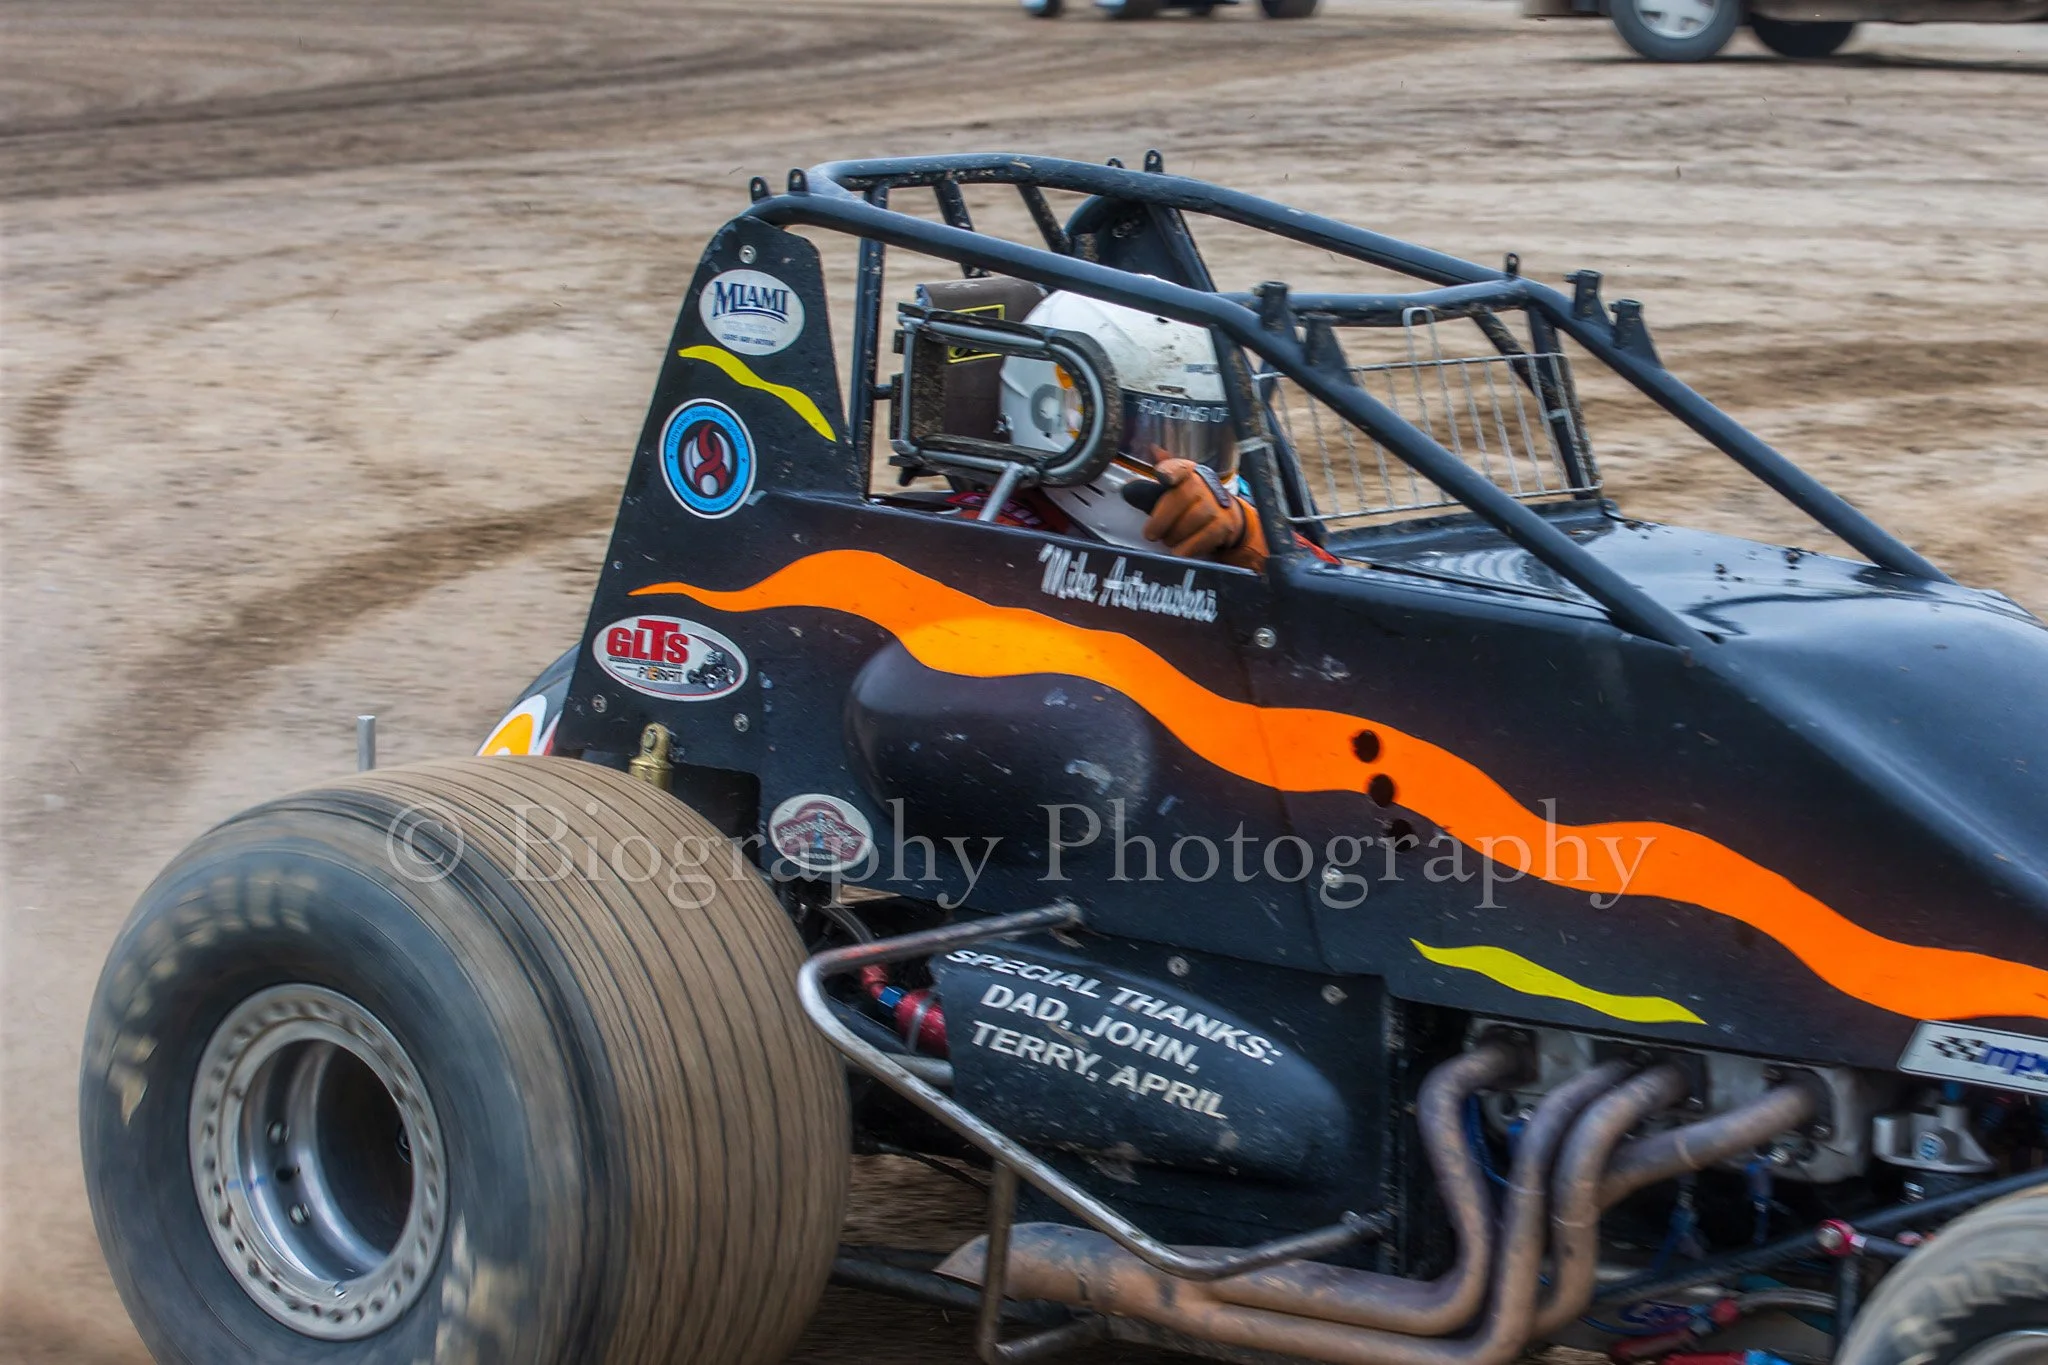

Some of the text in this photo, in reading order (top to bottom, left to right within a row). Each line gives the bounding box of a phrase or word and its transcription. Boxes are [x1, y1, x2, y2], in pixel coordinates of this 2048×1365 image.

[712, 281, 789, 317] MIAMI
[1038, 543, 1098, 602] Mike
[946, 949, 1284, 1067] SPECIAL THANKS:
[980, 984, 1074, 1030] DAD,
[971, 1020, 1229, 1120] TERRY, APRIL
